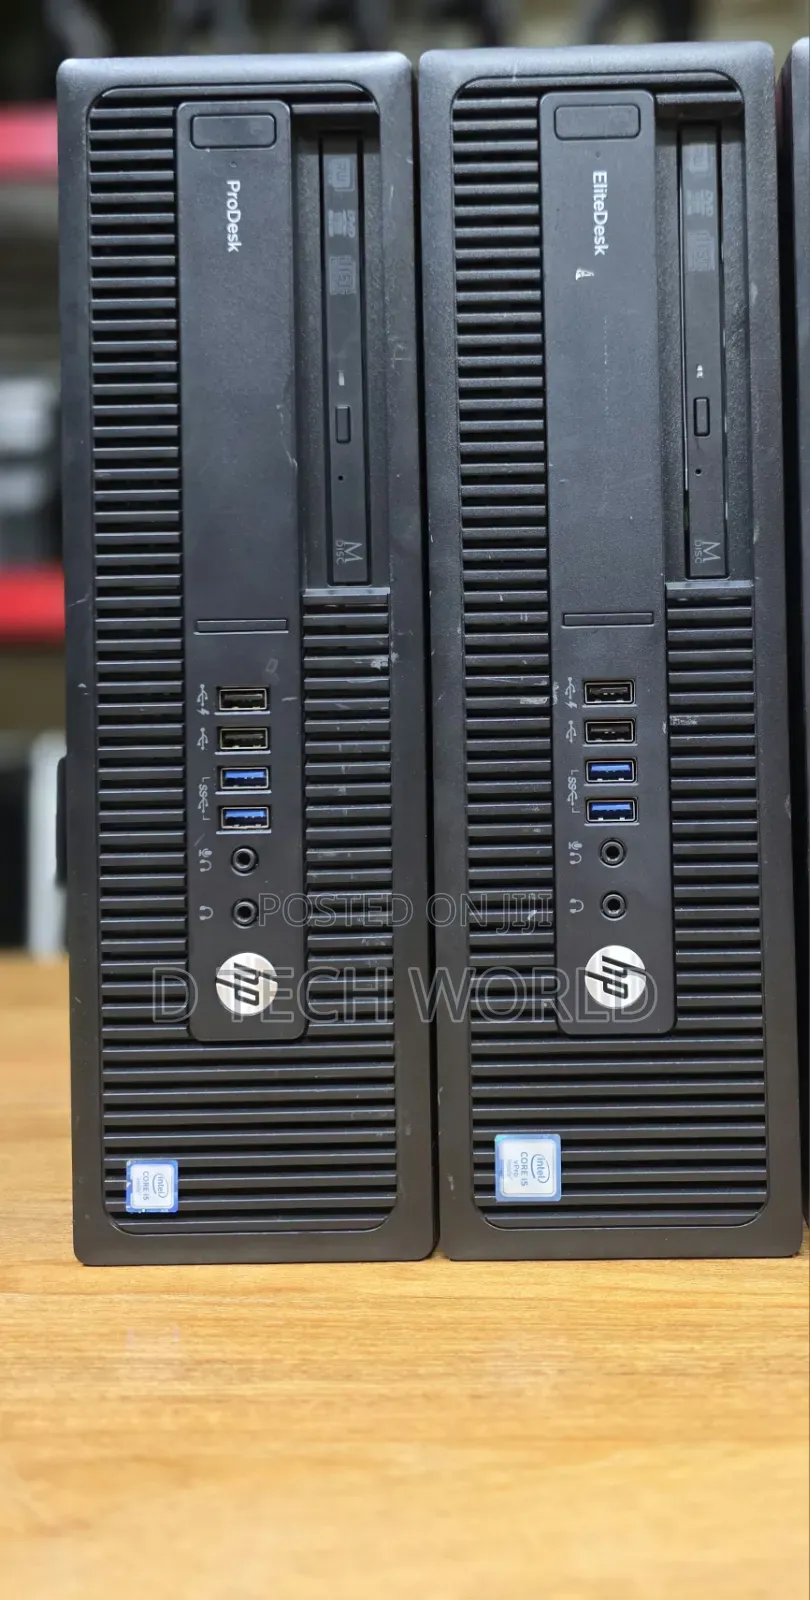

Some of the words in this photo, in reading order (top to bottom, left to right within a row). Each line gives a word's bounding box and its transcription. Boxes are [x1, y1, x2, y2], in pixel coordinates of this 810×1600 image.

[226, 180, 242, 252] ProDesk
[592, 171, 609, 256] EliteDesk
[335, 540, 344, 565] DISC
[344, 541, 363, 564] M
[694, 540, 702, 563] DISC
[702, 541, 721, 563] M
[215, 961, 278, 1007] hp
[584, 954, 647, 1000] hp
[520, 1151, 529, 1177] CORE
[536, 1157, 546, 1179] intel
[142, 1170, 150, 1193] CORE
[157, 1176, 166, 1194] intel
[520, 1178, 529, 1187] i5
